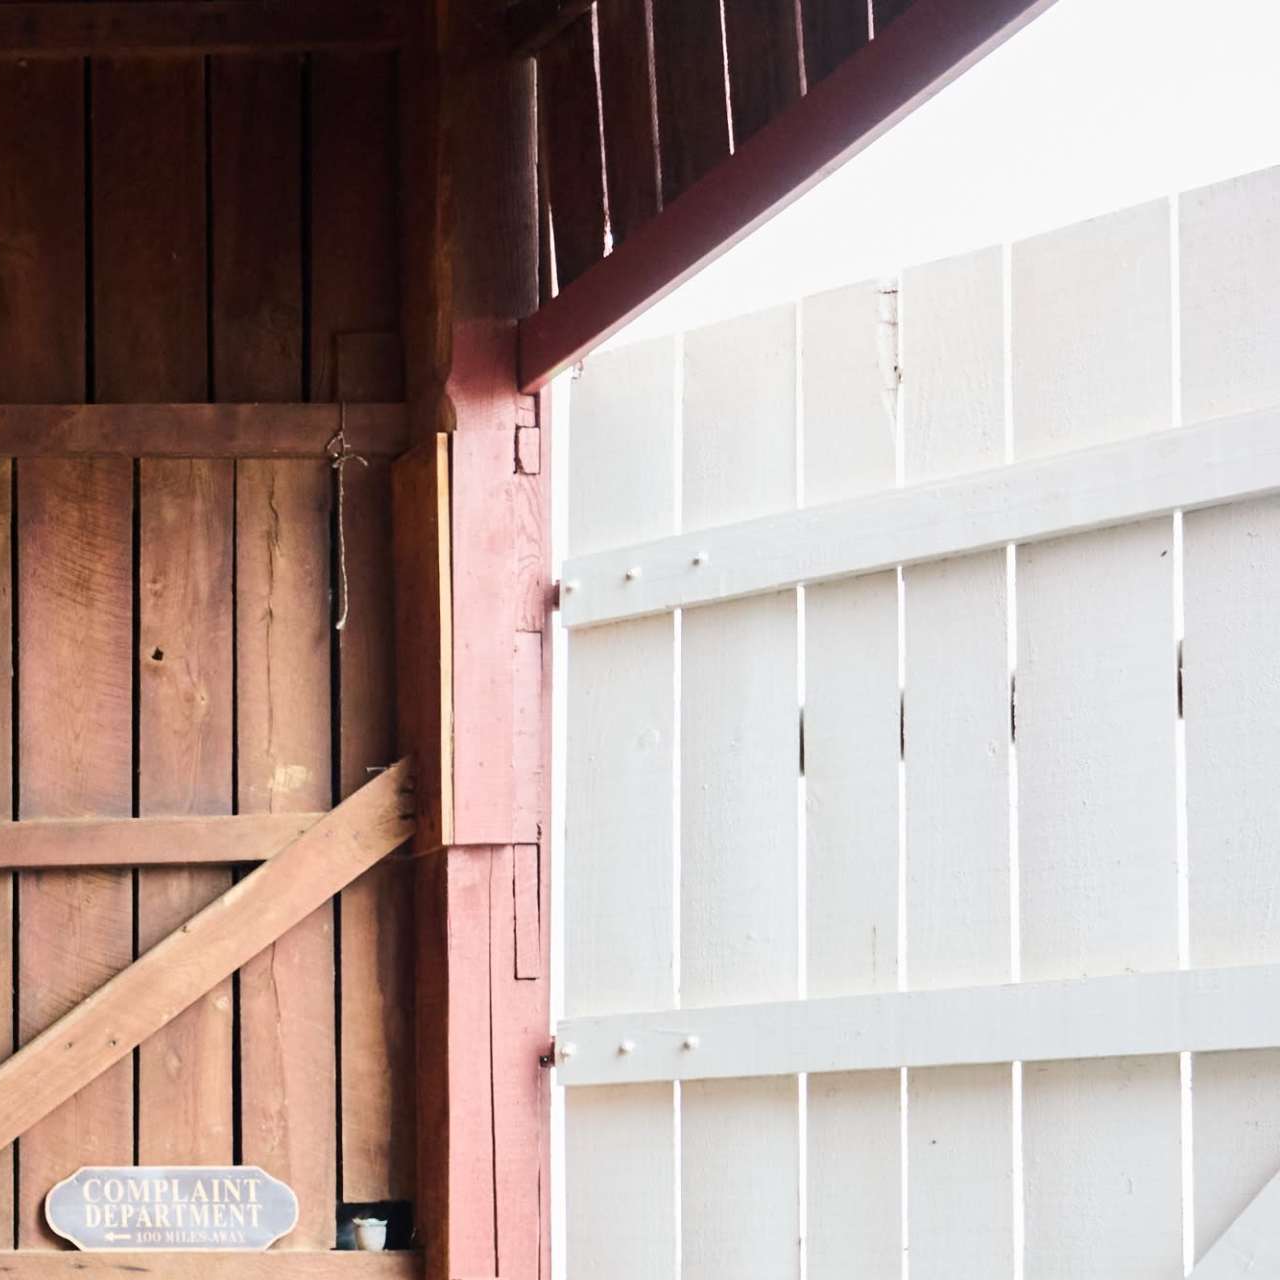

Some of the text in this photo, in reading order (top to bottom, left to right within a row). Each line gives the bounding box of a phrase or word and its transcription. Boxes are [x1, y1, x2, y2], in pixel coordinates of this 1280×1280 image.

[83, 1179, 260, 1202] COMPLAINT
[85, 1205, 261, 1228] DEPARTMENT
[136, 1231, 246, 1243] 100 MILES AWAY
